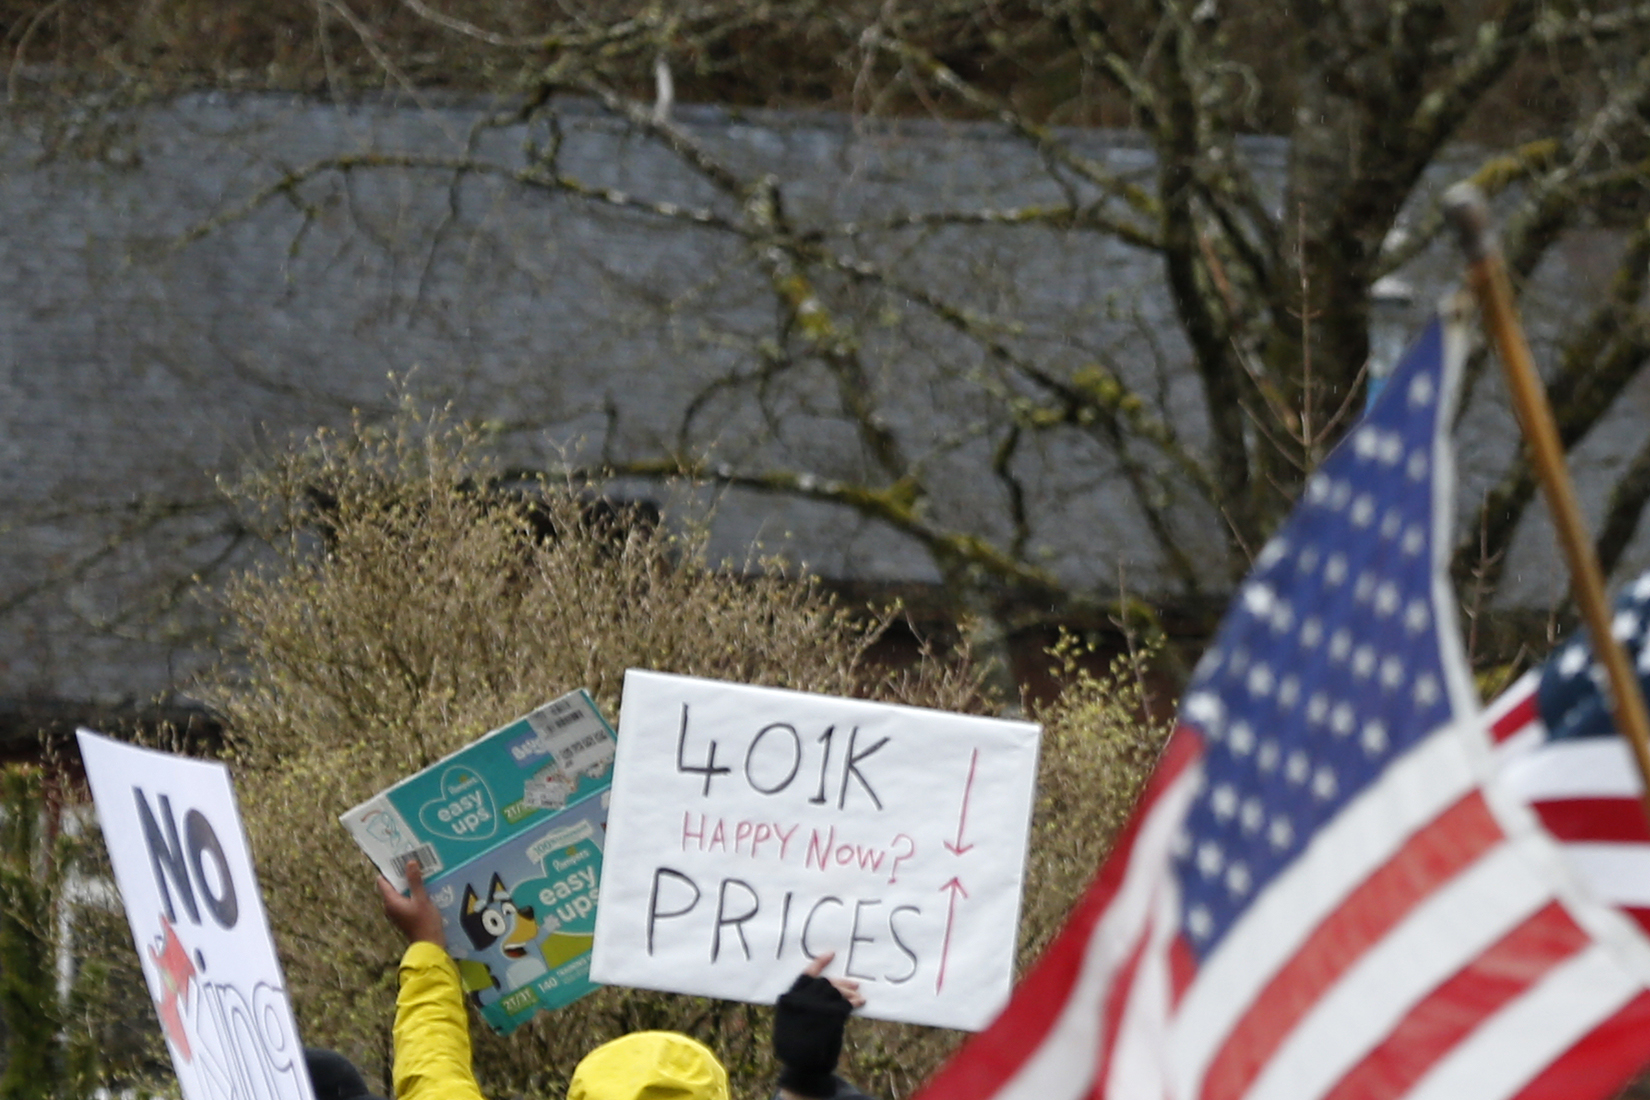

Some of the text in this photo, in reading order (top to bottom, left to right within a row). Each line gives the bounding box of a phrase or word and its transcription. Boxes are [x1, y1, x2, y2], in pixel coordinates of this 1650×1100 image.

[677, 702, 891, 811] 401K
[437, 789, 484, 822] easy
[450, 809, 493, 836] ups
[131, 785, 239, 931] NO
[681, 810, 800, 861] HAPPY
[539, 865, 597, 905] easy
[647, 866, 922, 985] PRICES
